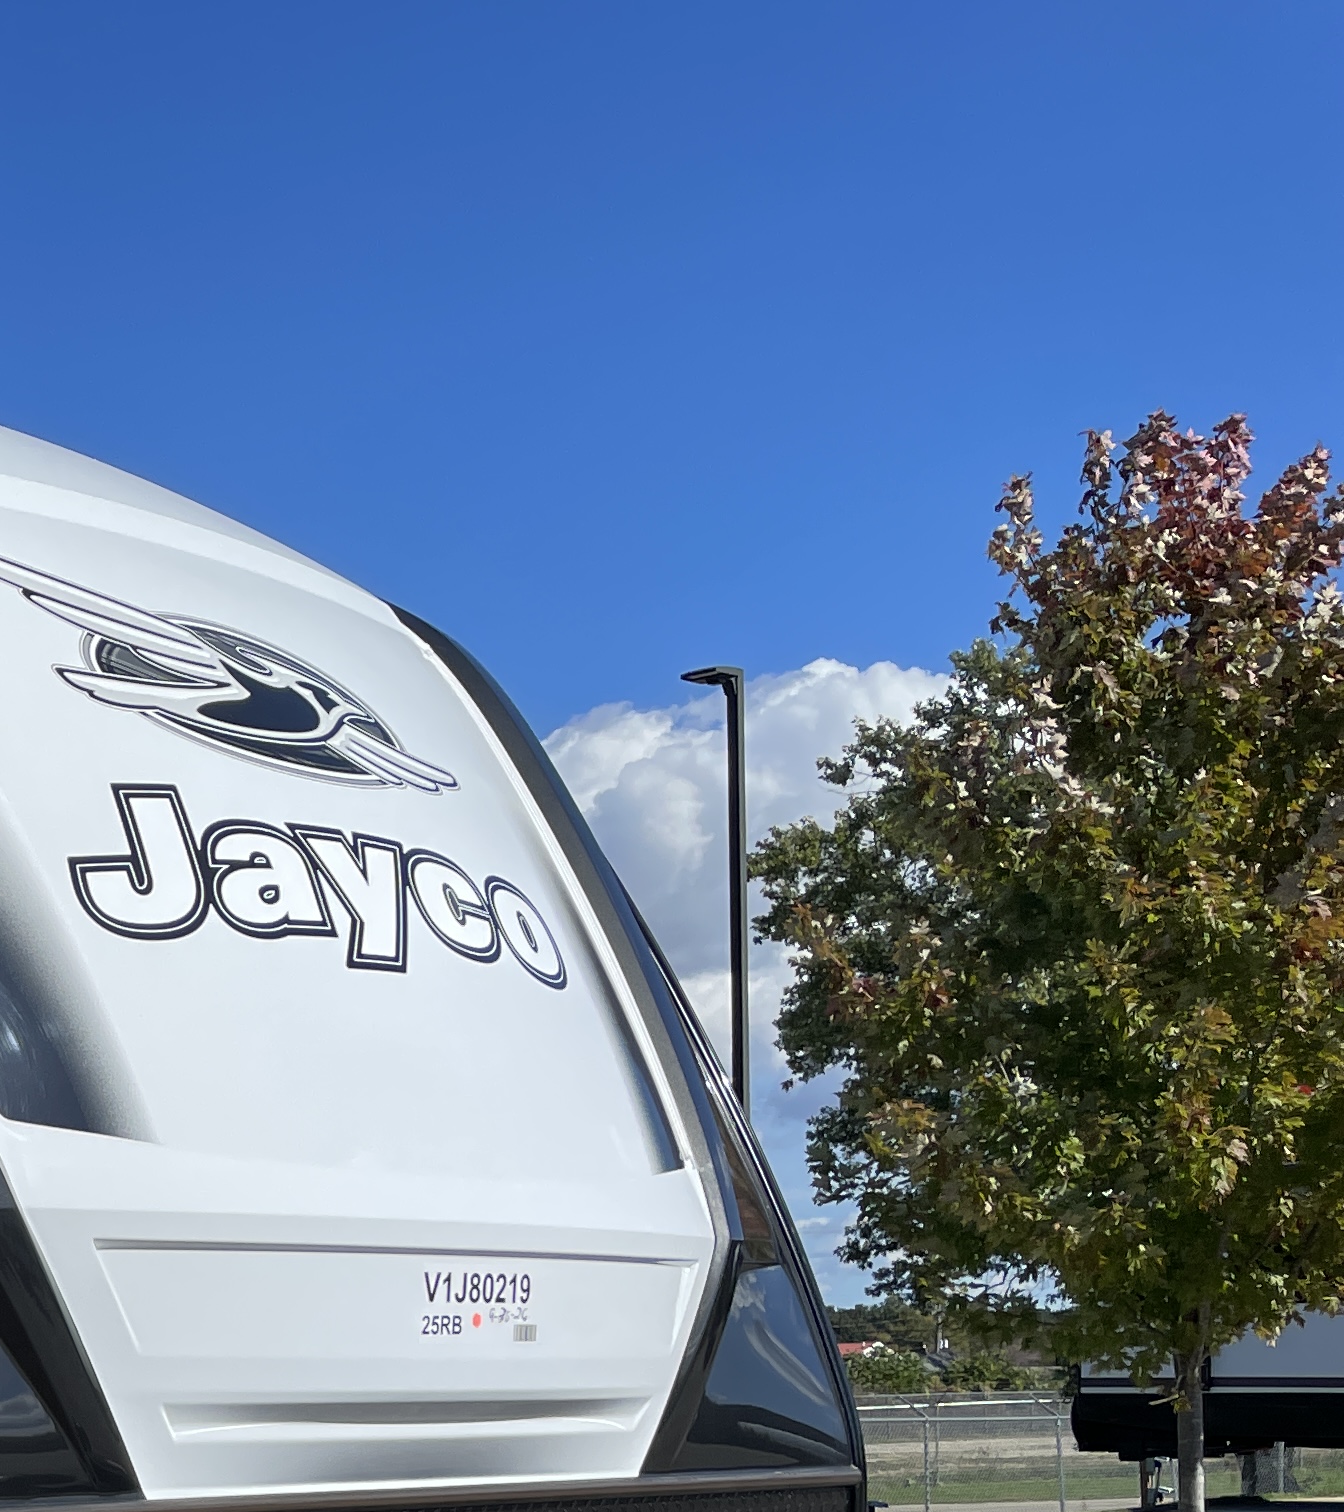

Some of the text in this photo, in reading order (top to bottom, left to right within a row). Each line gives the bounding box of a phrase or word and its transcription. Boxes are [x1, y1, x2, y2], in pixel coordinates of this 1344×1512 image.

[68, 783, 568, 990] Jayco
[424, 1271, 531, 1304] V1J80219
[421, 1315, 462, 1335] 25RB
